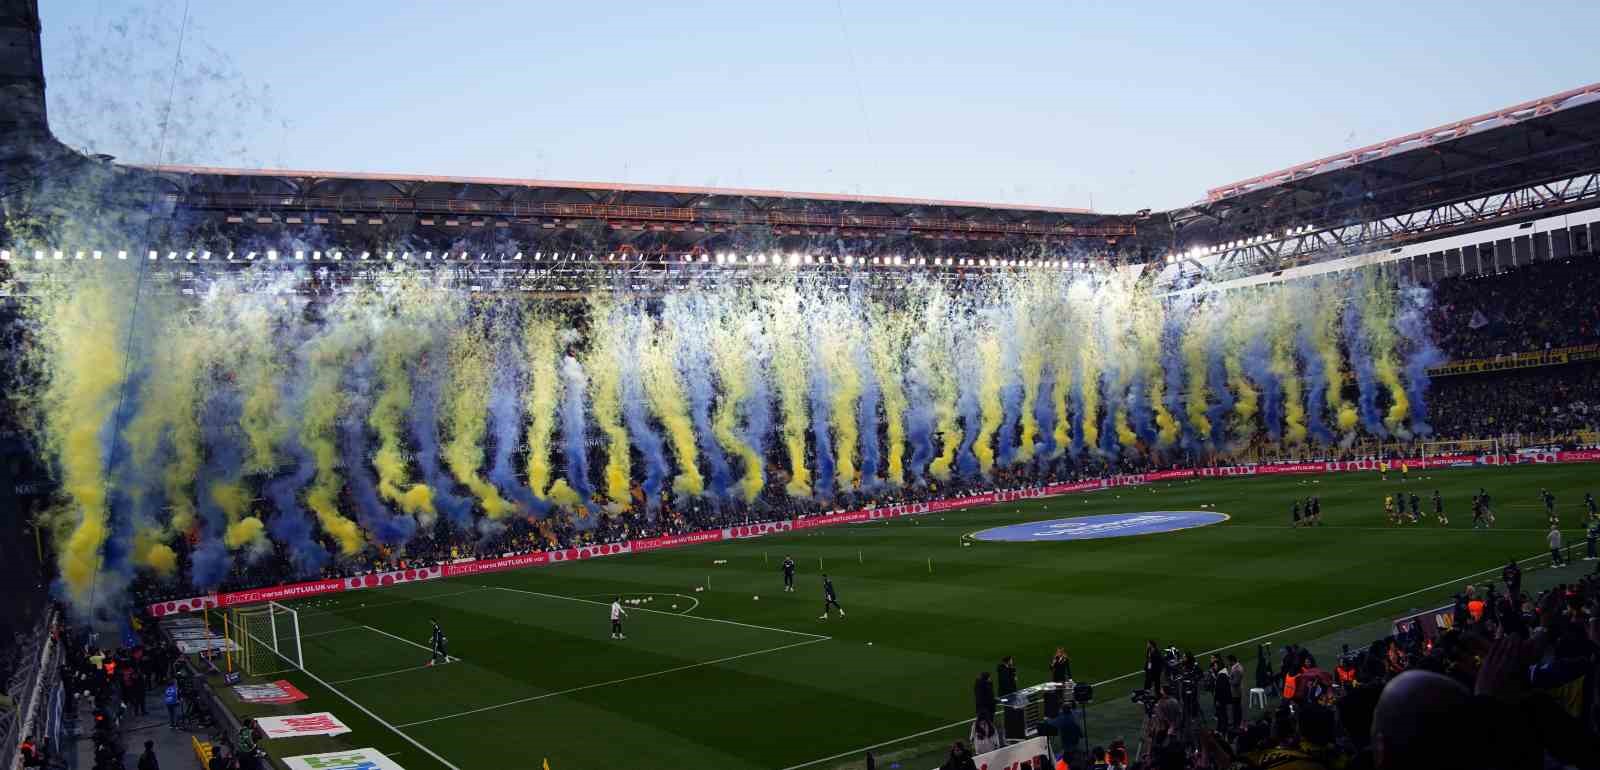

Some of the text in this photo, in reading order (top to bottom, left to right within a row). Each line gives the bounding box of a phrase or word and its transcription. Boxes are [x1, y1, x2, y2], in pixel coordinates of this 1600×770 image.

[497, 557, 533, 568] MUTLULUK
[261, 589, 283, 598] varsa
[283, 583, 326, 595] MUTLULUK
[326, 583, 338, 591] var
